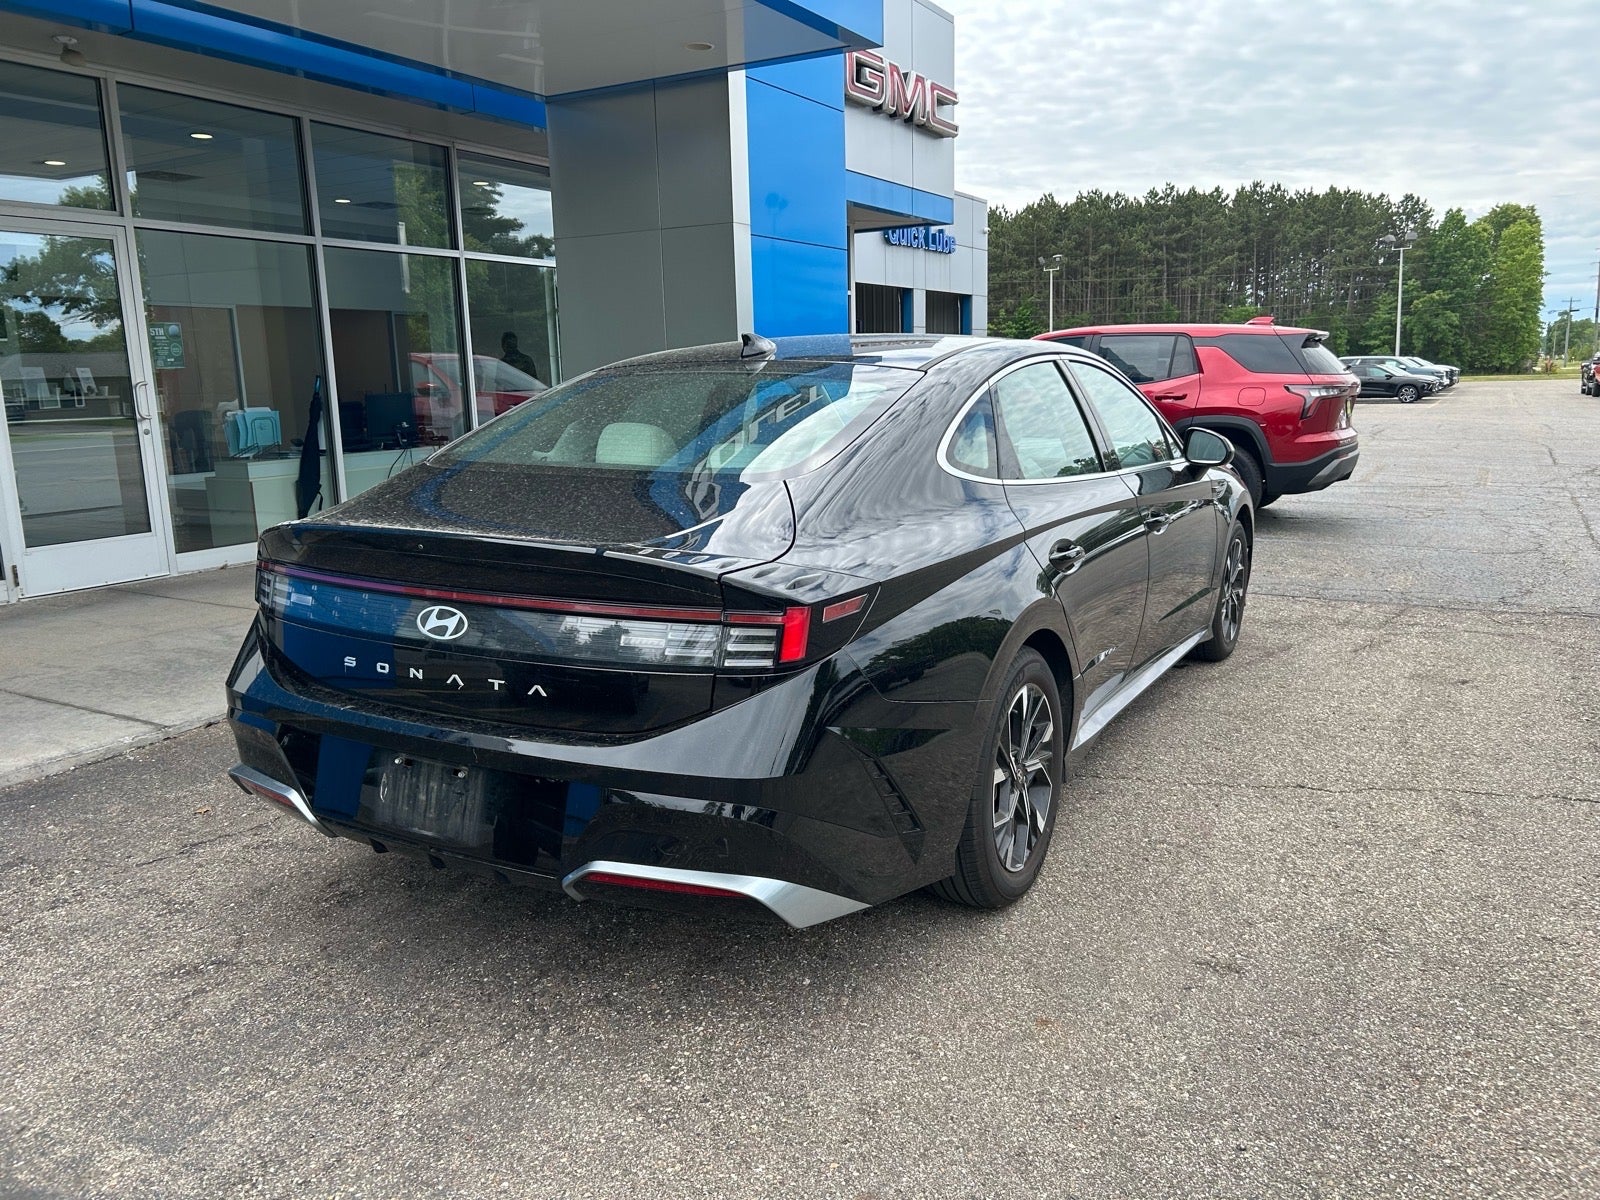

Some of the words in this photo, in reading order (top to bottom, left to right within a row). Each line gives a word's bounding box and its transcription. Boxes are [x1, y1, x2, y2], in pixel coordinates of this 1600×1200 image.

[845, 50, 959, 137] GMC
[888, 227, 927, 249] Quick
[928, 228, 956, 254] Lube
[343, 656, 548, 697] SONATA
